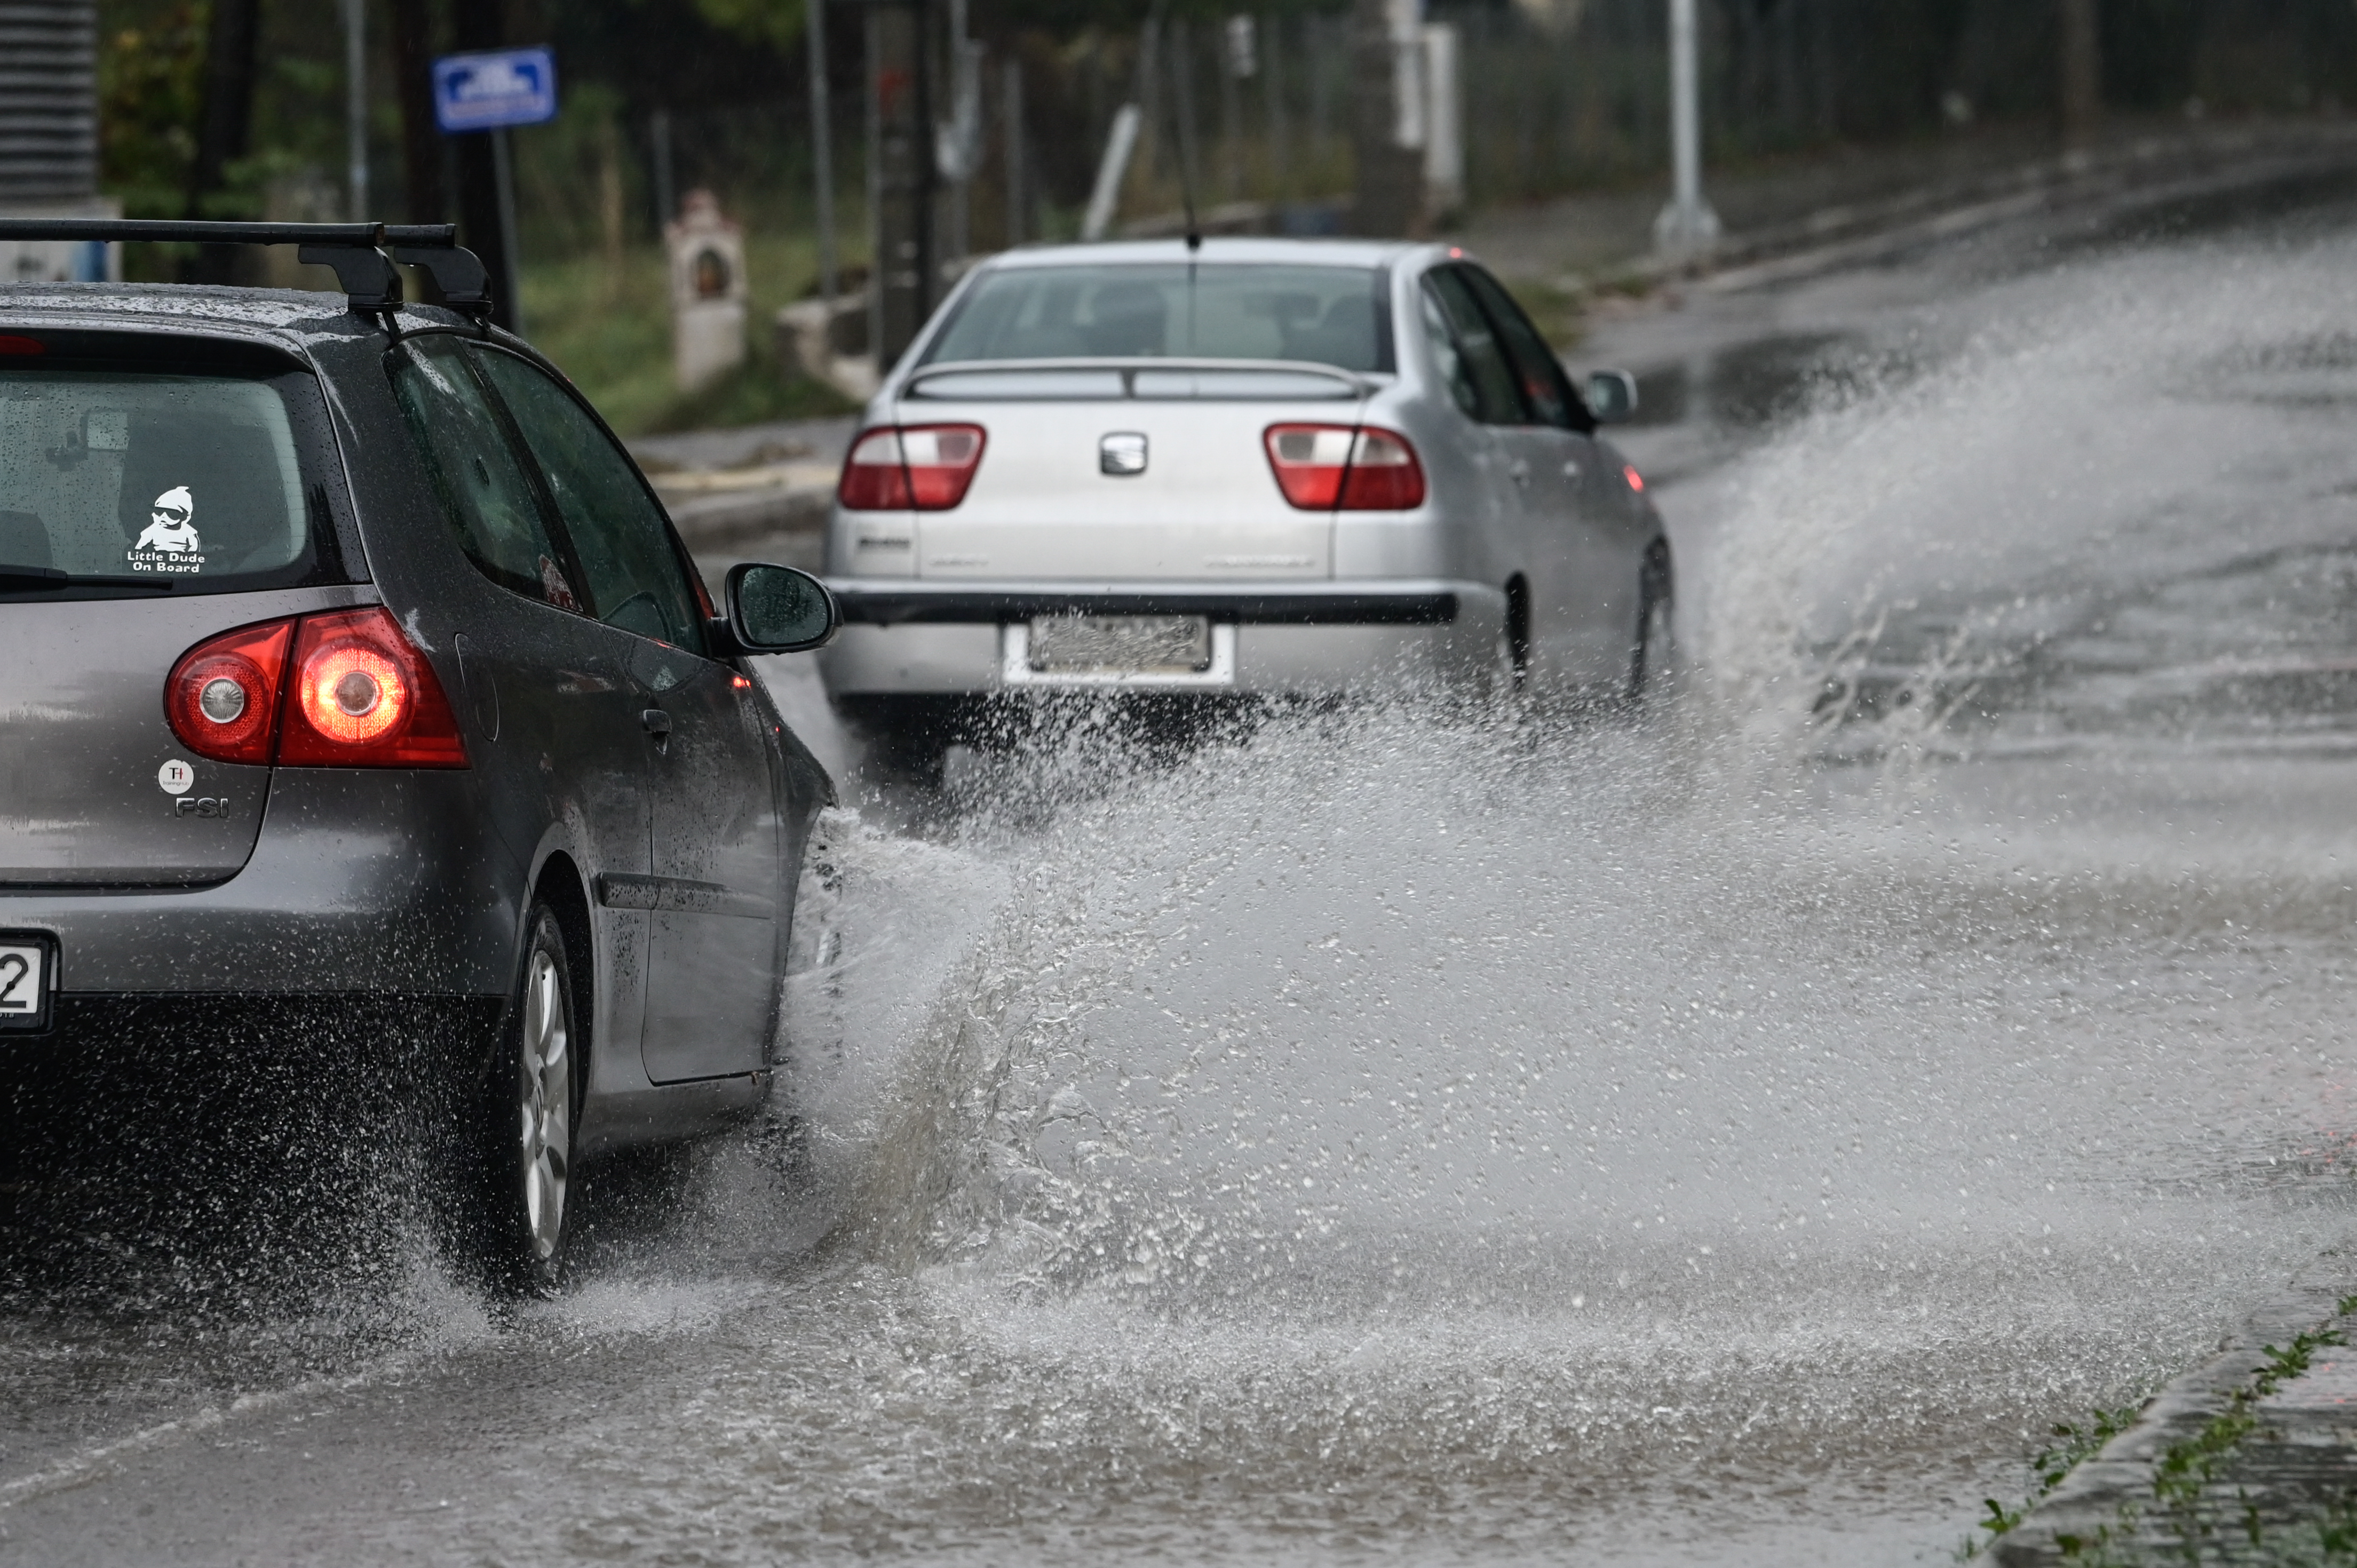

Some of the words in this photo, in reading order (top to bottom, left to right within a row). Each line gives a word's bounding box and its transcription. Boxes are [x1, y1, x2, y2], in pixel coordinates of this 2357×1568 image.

[128, 551, 163, 561] Little
[169, 553, 205, 563] Dude
[133, 562, 151, 571] On
[157, 562, 199, 572] Board
[176, 797, 229, 818] FSI
[0, 953, 29, 1009] 2
